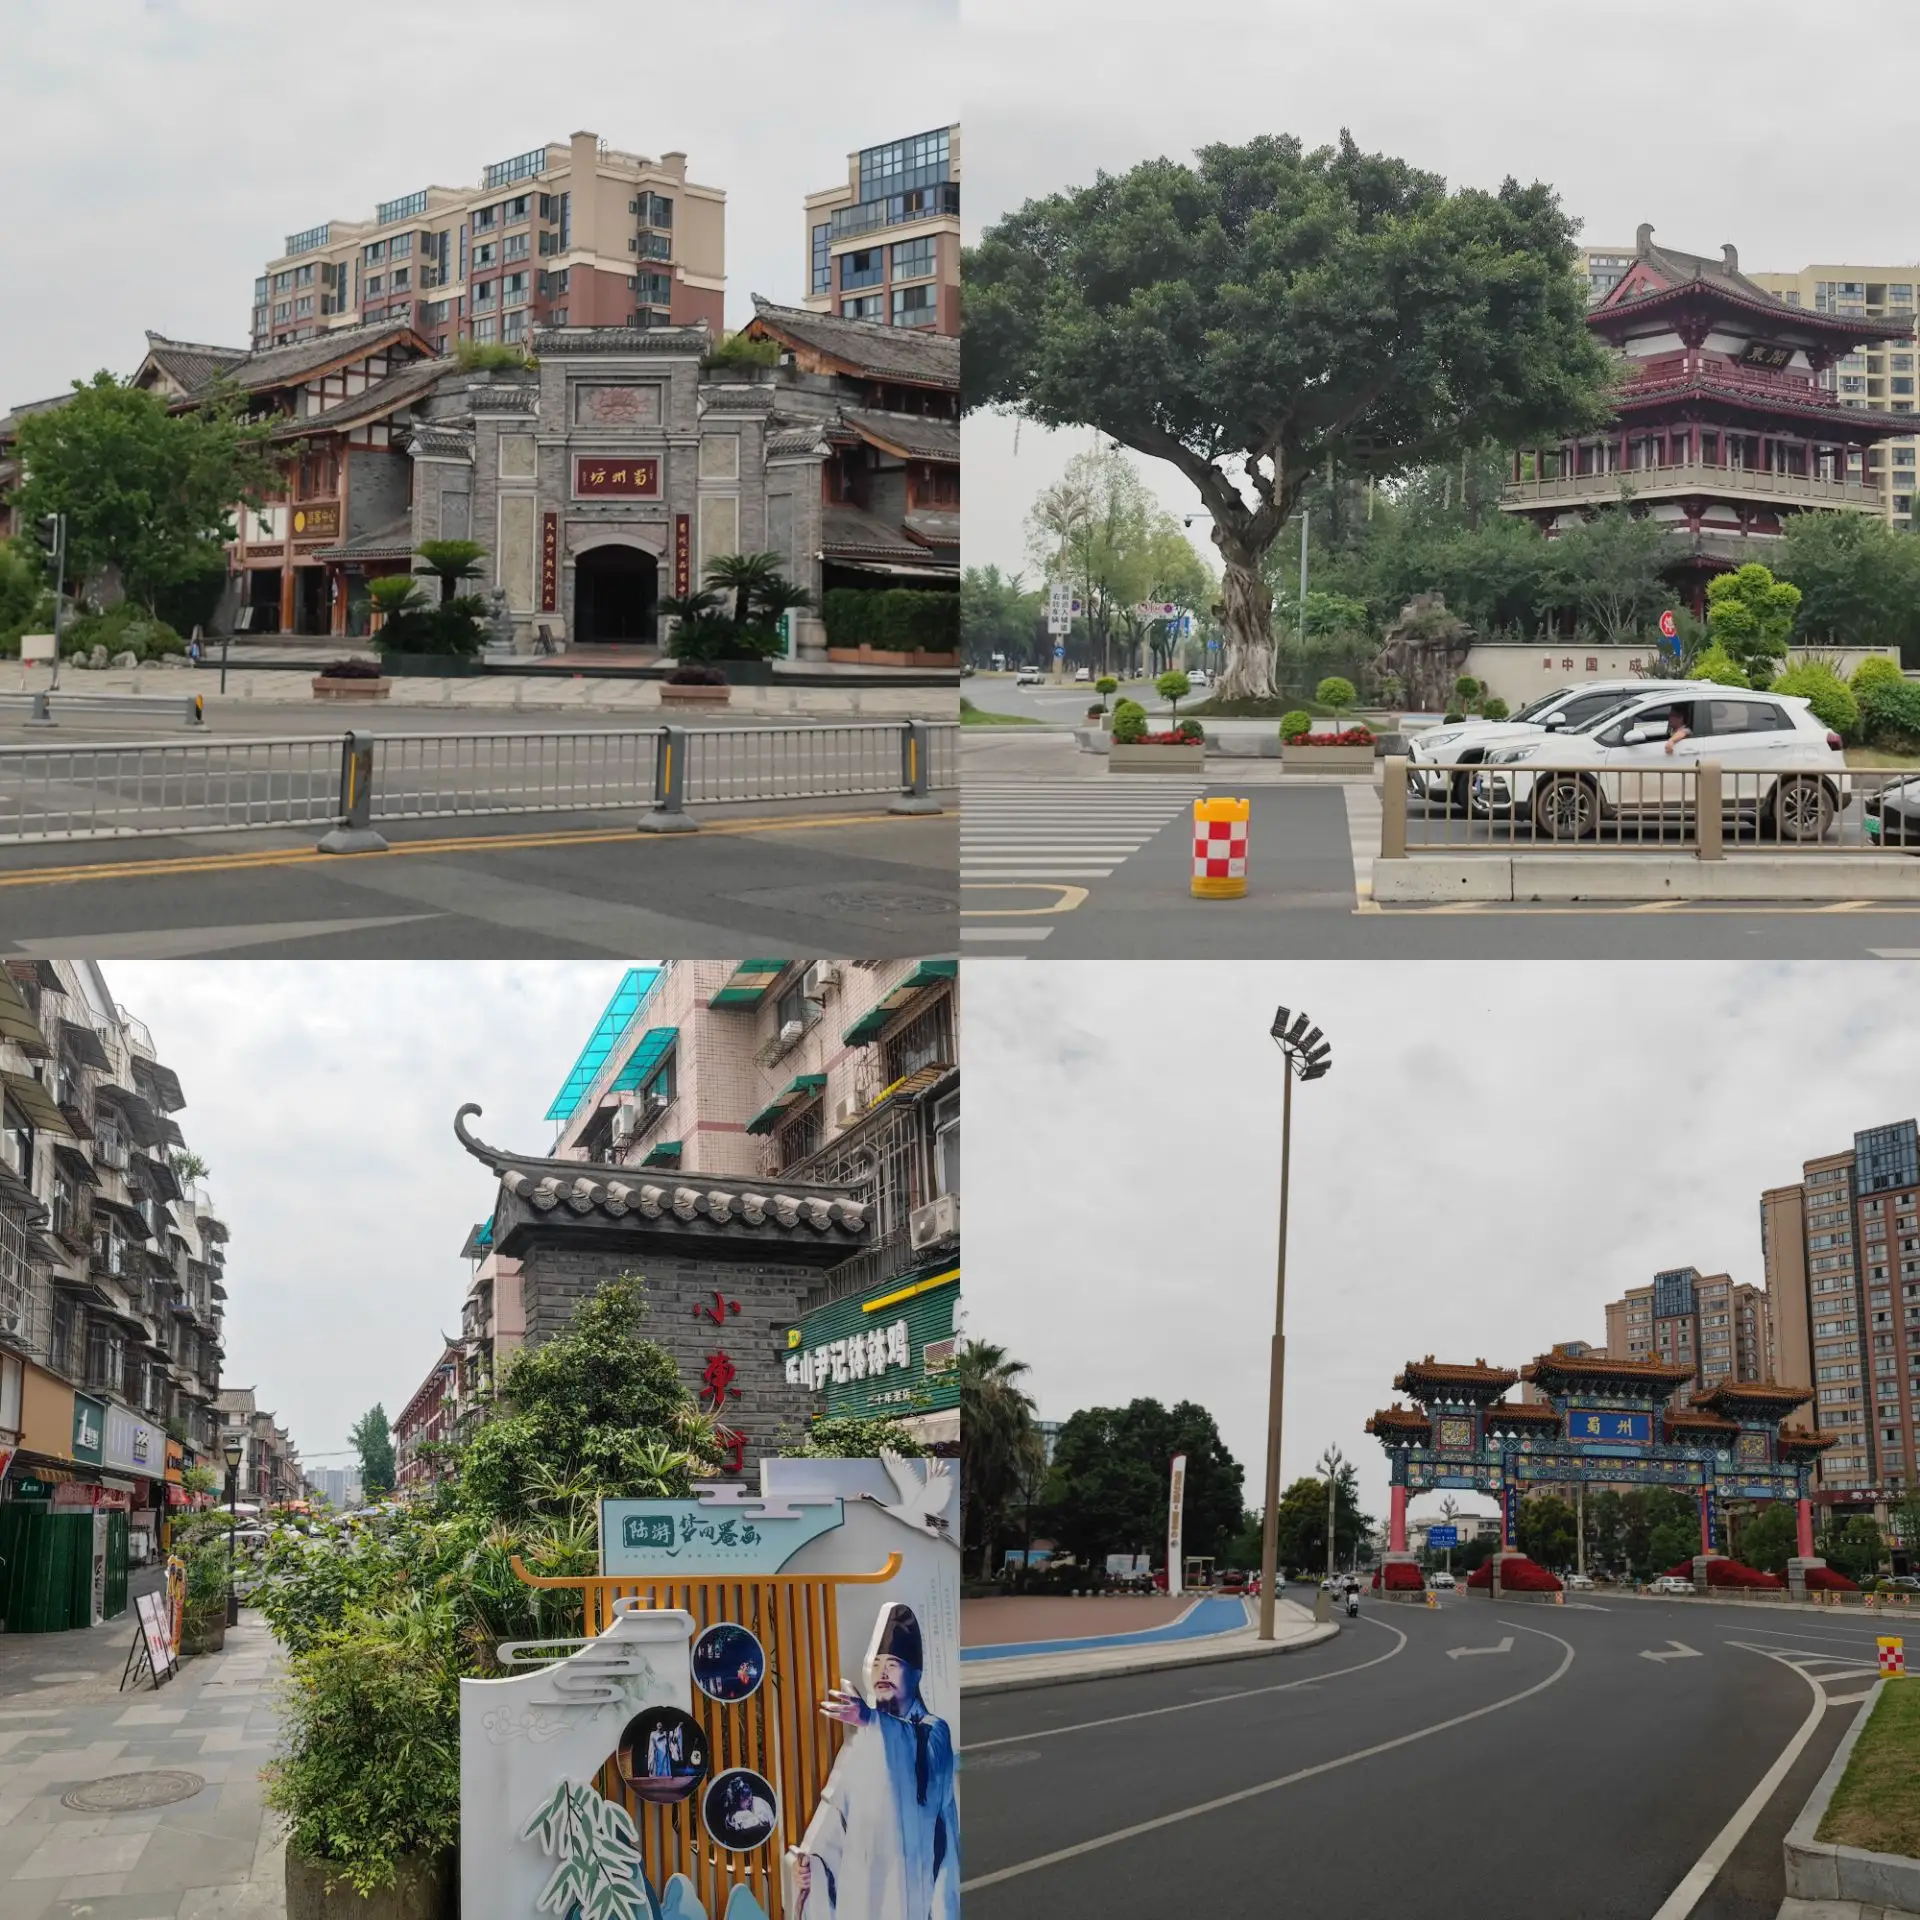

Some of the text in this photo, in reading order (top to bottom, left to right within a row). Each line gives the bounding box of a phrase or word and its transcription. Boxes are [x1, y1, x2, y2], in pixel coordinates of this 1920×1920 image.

[590, 467, 647, 487] 蜀州坊
[1587, 1416, 1632, 1437] 蜀州
[628, 1519, 672, 1543] 陆游
